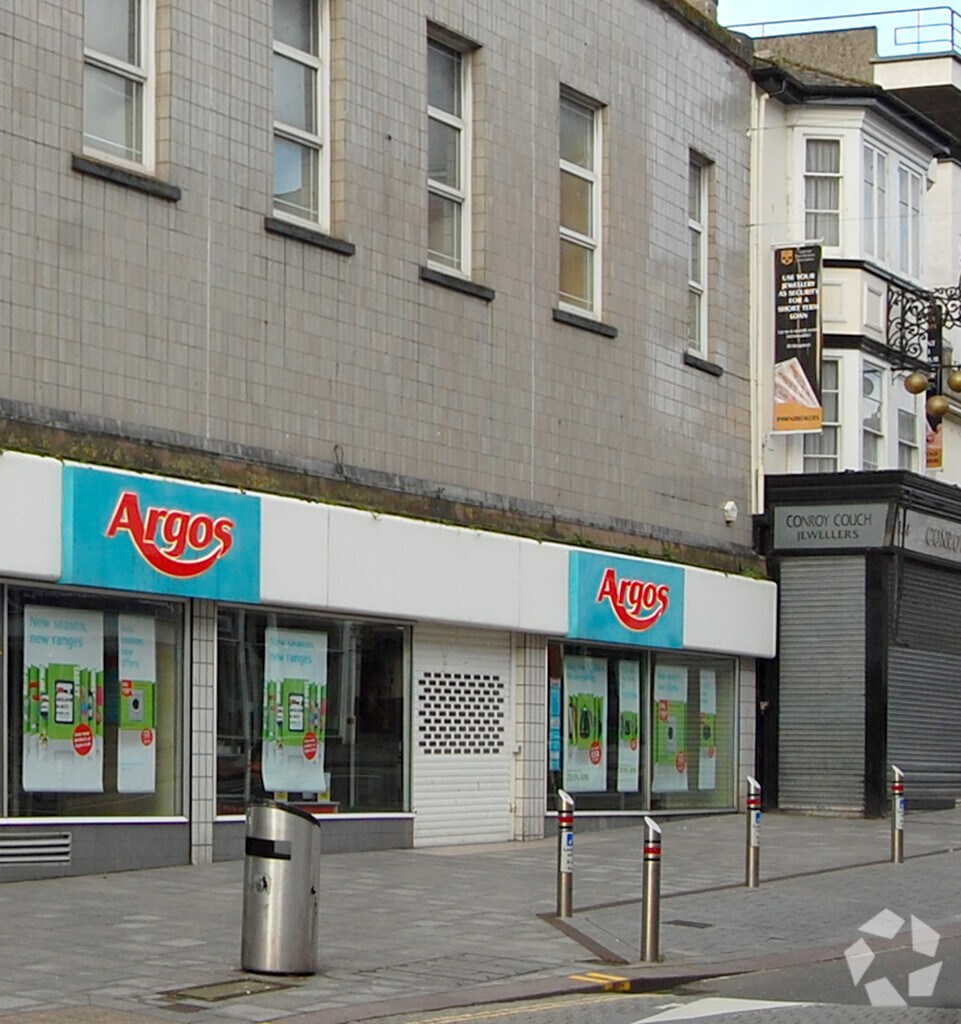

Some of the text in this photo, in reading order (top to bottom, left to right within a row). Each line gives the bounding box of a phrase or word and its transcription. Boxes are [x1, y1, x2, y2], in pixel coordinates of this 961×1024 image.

[796, 272, 815, 280] YOUR
[786, 513, 872, 528] CONROY COUCH
[105, 491, 236, 579] Argos
[797, 529, 860, 541] JEWELLERS
[595, 567, 670, 632] Argos
[30, 617, 50, 628] New
[30, 635, 84, 650] new ranges
